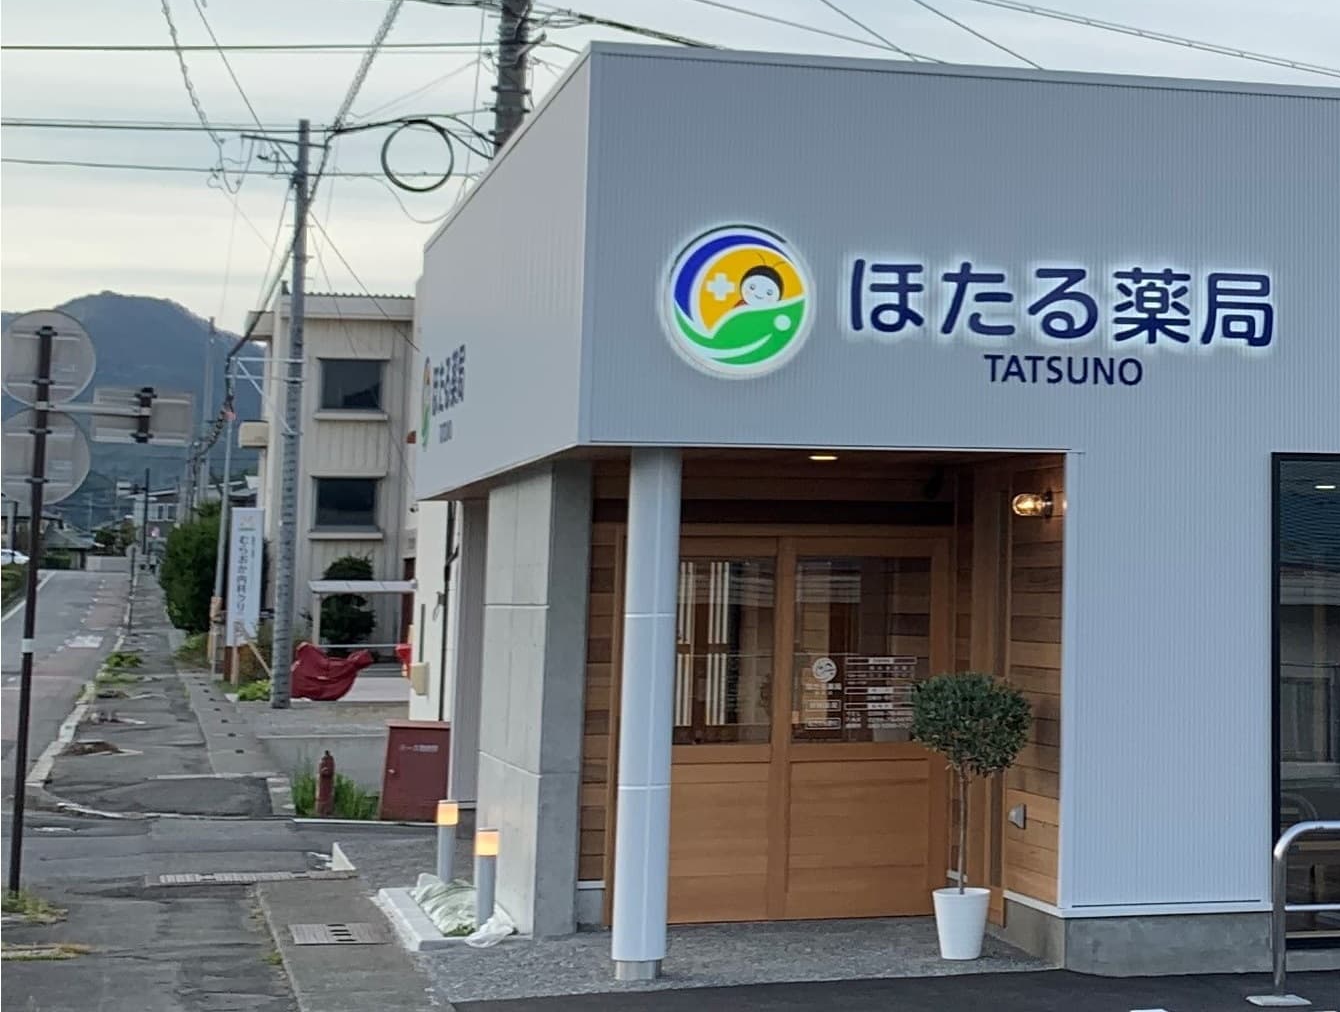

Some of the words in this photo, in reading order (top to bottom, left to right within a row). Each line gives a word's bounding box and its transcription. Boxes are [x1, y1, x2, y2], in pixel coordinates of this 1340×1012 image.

[850, 259, 1274, 347] ほたる薬局
[983, 354, 1144, 386] TATSUNO
